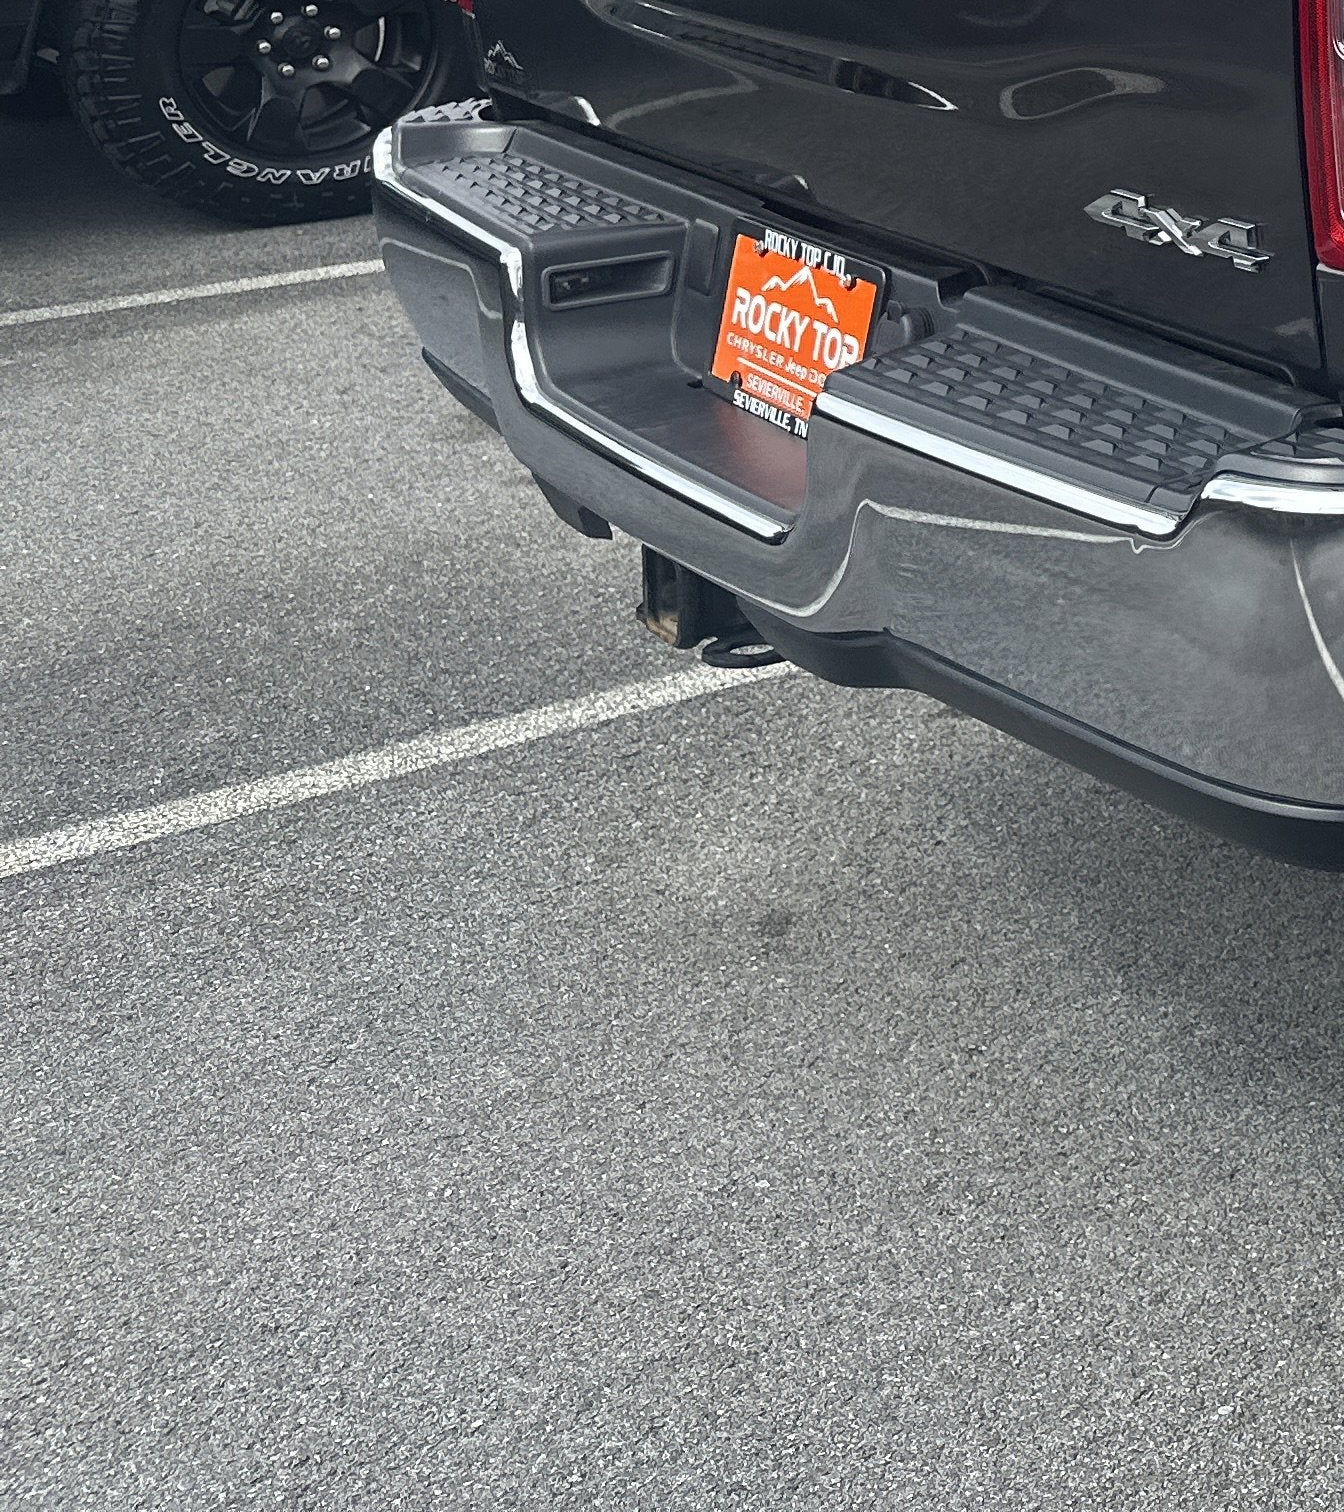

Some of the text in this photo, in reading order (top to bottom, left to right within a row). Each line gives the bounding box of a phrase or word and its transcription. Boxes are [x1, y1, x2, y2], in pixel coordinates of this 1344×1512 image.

[764, 229, 798, 260] ROCKY
[801, 243, 822, 268] TOP
[732, 287, 860, 370] ROCKY TOP
[727, 332, 785, 370] CHRYSLER
[785, 356, 808, 382] Jeep
[733, 389, 809, 438] SEVIERVILLE, TN
